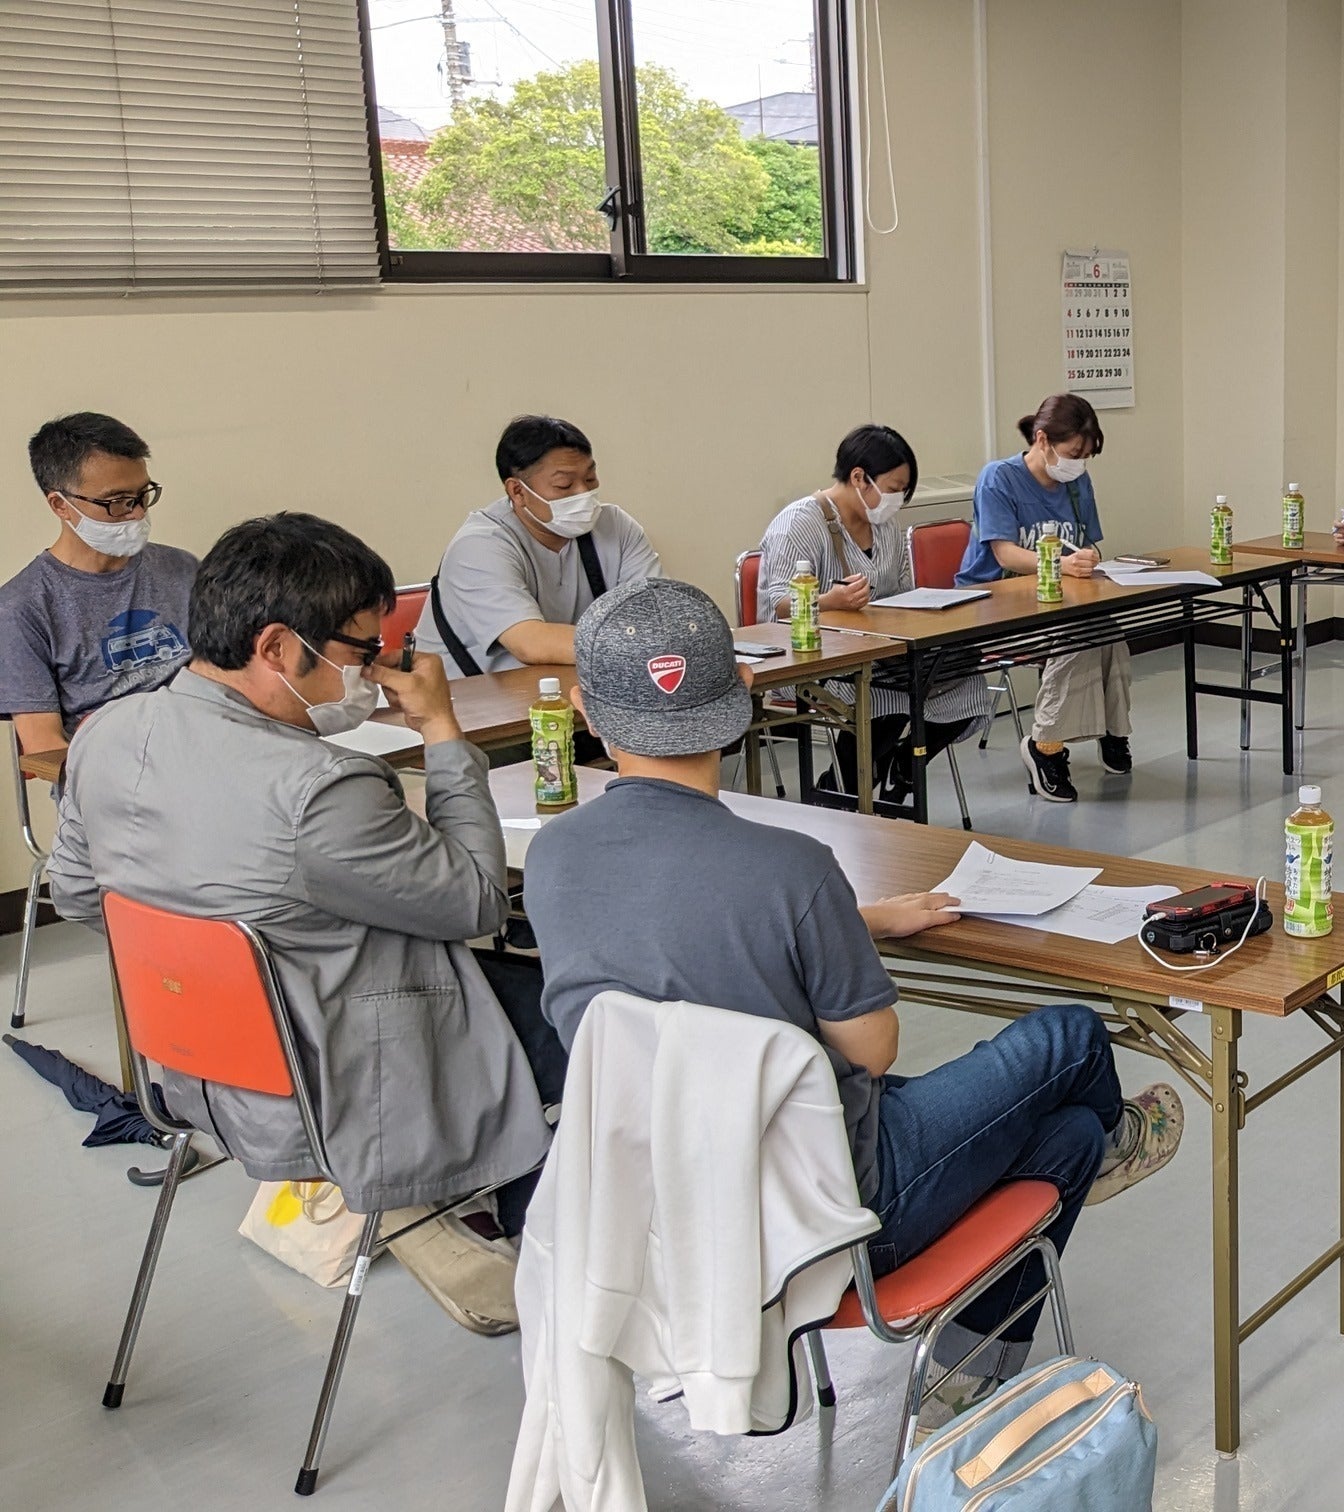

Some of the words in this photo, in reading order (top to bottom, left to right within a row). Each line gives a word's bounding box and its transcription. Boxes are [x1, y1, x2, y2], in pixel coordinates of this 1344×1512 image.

[1093, 264, 1100, 278] 6
[1105, 289, 1108, 297] 1
[1114, 289, 1118, 297] 2
[1123, 289, 1127, 297] 3
[1068, 309, 1072, 317] 4
[1077, 309, 1081, 317] 5
[1086, 309, 1090, 317] 6
[1096, 309, 1099, 317] 7
[1105, 309, 1109, 317] 8
[1114, 309, 1118, 317] 9
[1122, 309, 1129, 317] 10
[1067, 330, 1074, 338] 11
[1076, 330, 1083, 338] 12
[1086, 329, 1093, 338] 13
[1095, 329, 1102, 337] 14
[1104, 329, 1111, 337] 15
[1113, 329, 1120, 337] 16
[1122, 329, 1129, 337] 17
[1068, 350, 1075, 359] 18
[1077, 350, 1084, 358] 19
[1086, 350, 1093, 358] 20
[1095, 350, 1102, 358] 21
[1113, 349, 1121, 357] 23
[1068, 371, 1075, 379] 25
[1077, 370, 1085, 378] 26
[1087, 370, 1094, 378] 27
[1096, 369, 1103, 378] 28
[1105, 369, 1112, 377] 29
[1114, 369, 1122, 377] 30
[652, 660, 682, 669] DUCATI
